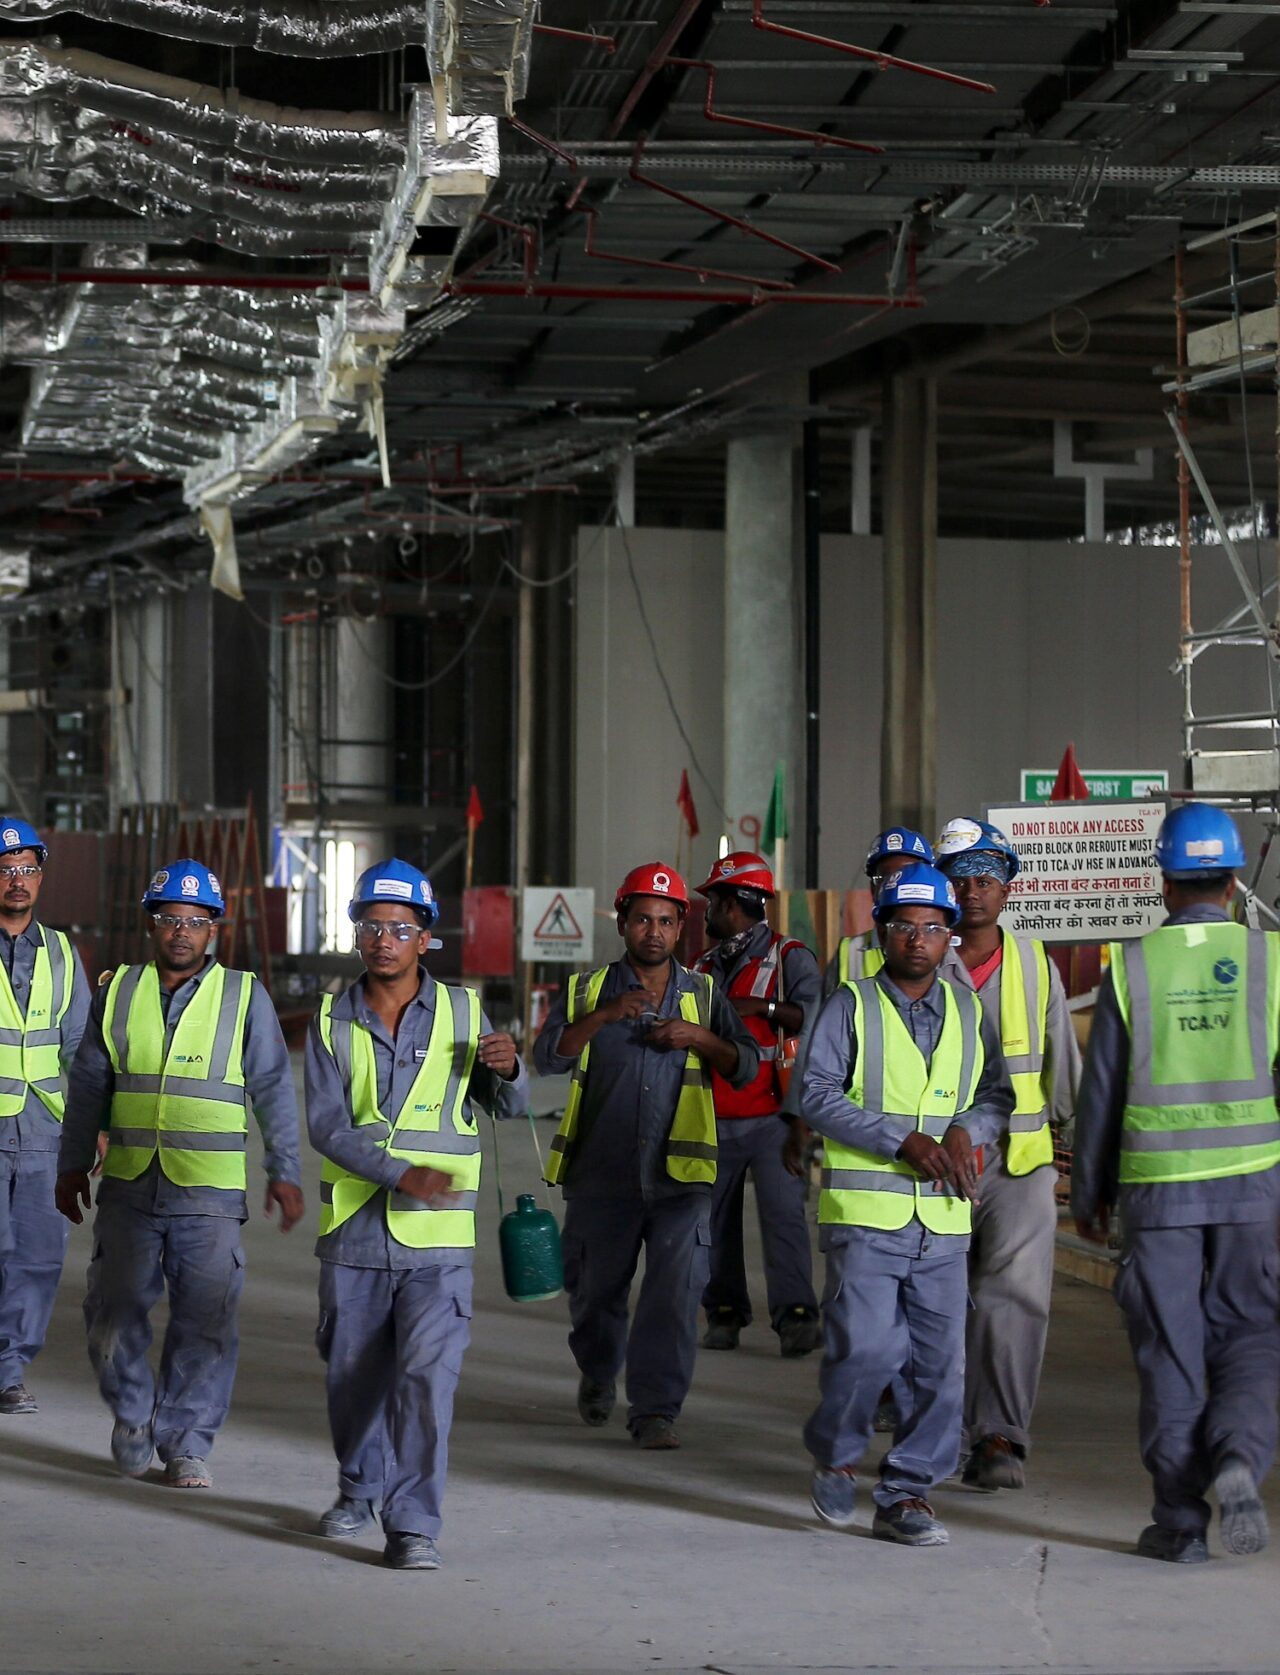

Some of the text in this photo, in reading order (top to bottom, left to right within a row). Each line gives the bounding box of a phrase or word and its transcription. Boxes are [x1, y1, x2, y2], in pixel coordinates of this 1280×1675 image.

[1085, 780, 1120, 797] FIRST
[1012, 818, 1144, 836] DO NOT BLOCK ANY ACCESS
[1045, 841, 1073, 855] BLOCK
[1075, 841, 1087, 854] OR
[1089, 839, 1127, 853] REROUTE
[1129, 839, 1152, 852] MUST
[1036, 859, 1048, 872] TO
[1086, 857, 1104, 870] HSE
[1106, 856, 1116, 869] IN
[1026, 877, 1039, 892] भी
[1042, 879, 1069, 892] रास्ता
[1092, 878, 1120, 890] करना
[1024, 900, 1051, 911] रास्ता
[1074, 898, 1102, 910] करना
